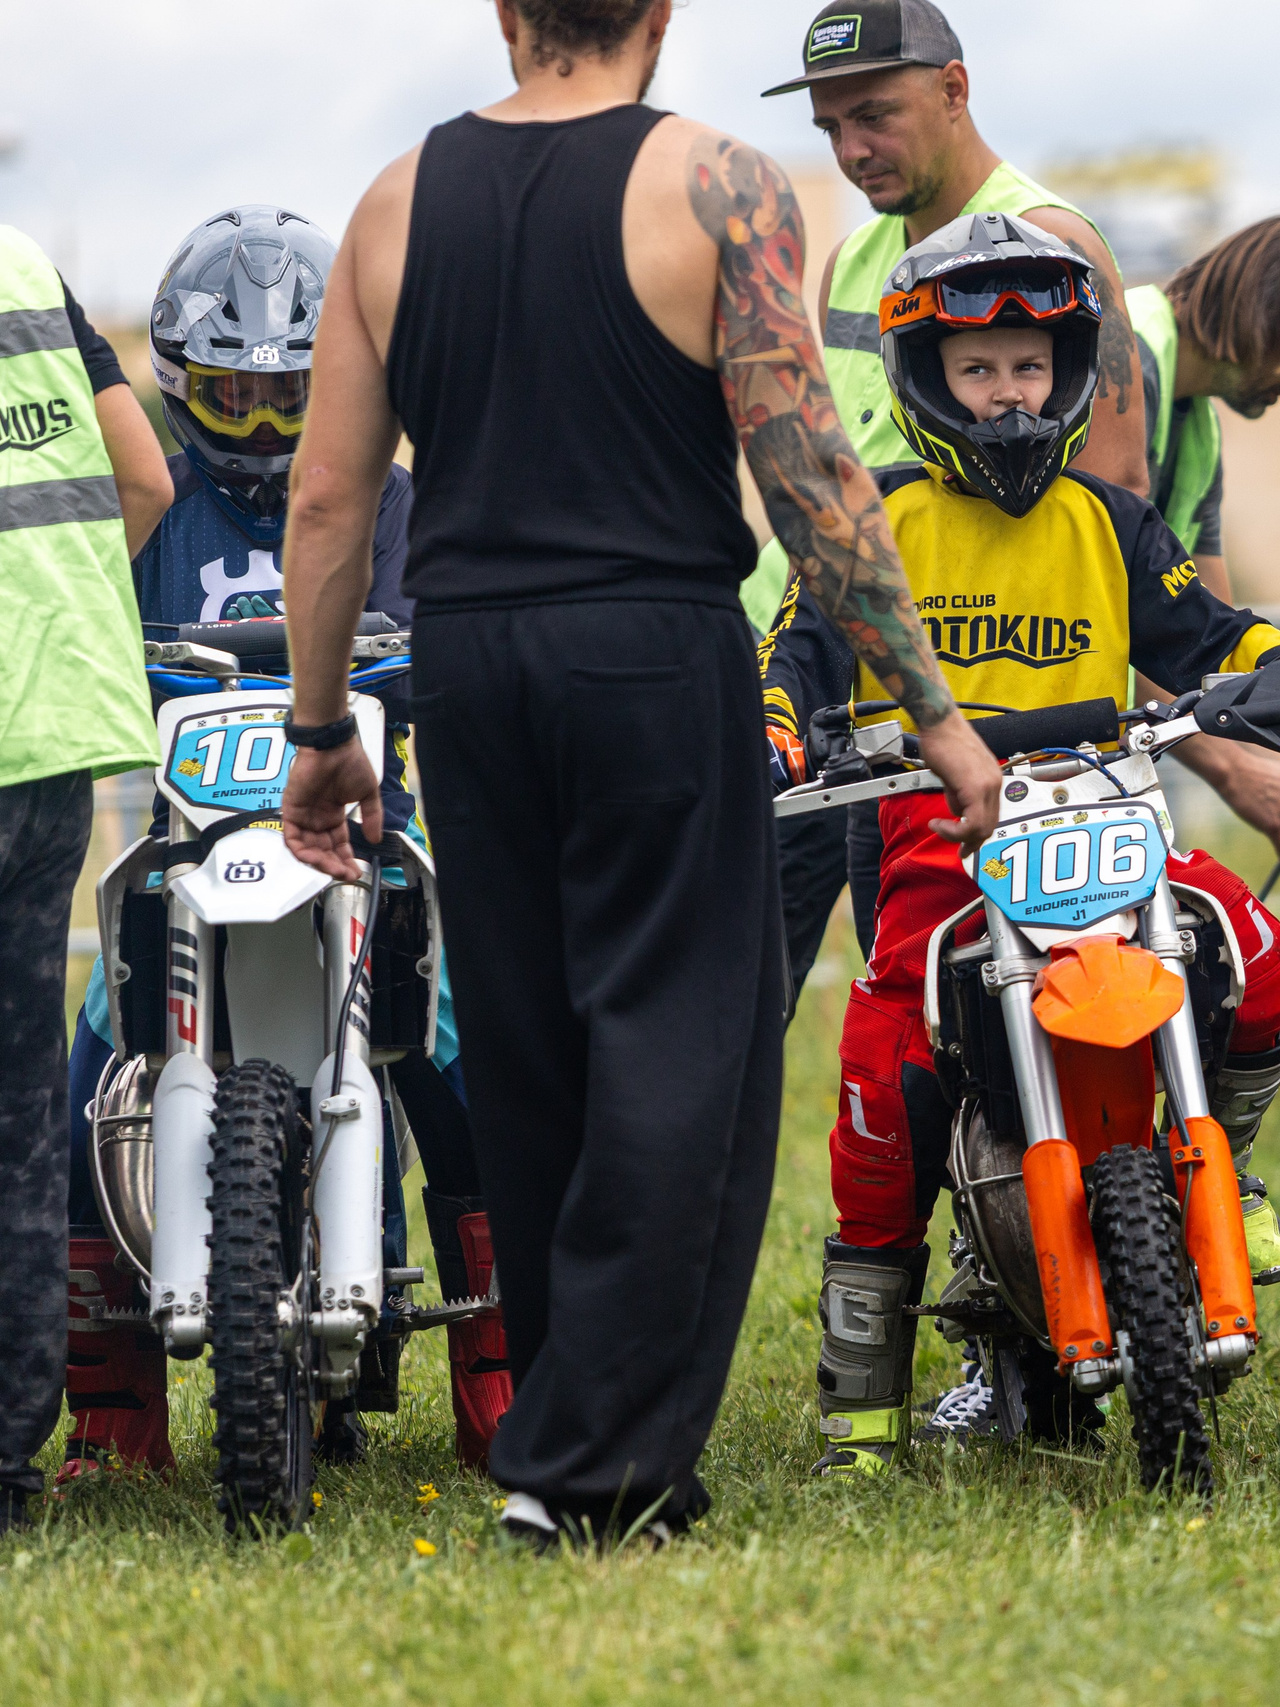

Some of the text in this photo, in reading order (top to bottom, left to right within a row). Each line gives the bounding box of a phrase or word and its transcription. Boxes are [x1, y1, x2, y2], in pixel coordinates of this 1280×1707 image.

[812, 22, 854, 40] Kawasaki
[890, 295, 920, 319] KTM
[951, 594, 996, 609] CLUB
[921, 614, 1093, 658] OTOKIDS
[195, 727, 297, 788] 10
[212, 787, 266, 799] ENDURO
[257, 799, 272, 809] J1
[1000, 822, 1148, 905] 106
[1025, 889, 1130, 916] ENDURO JUNIOR
[1072, 908, 1087, 922] J1
